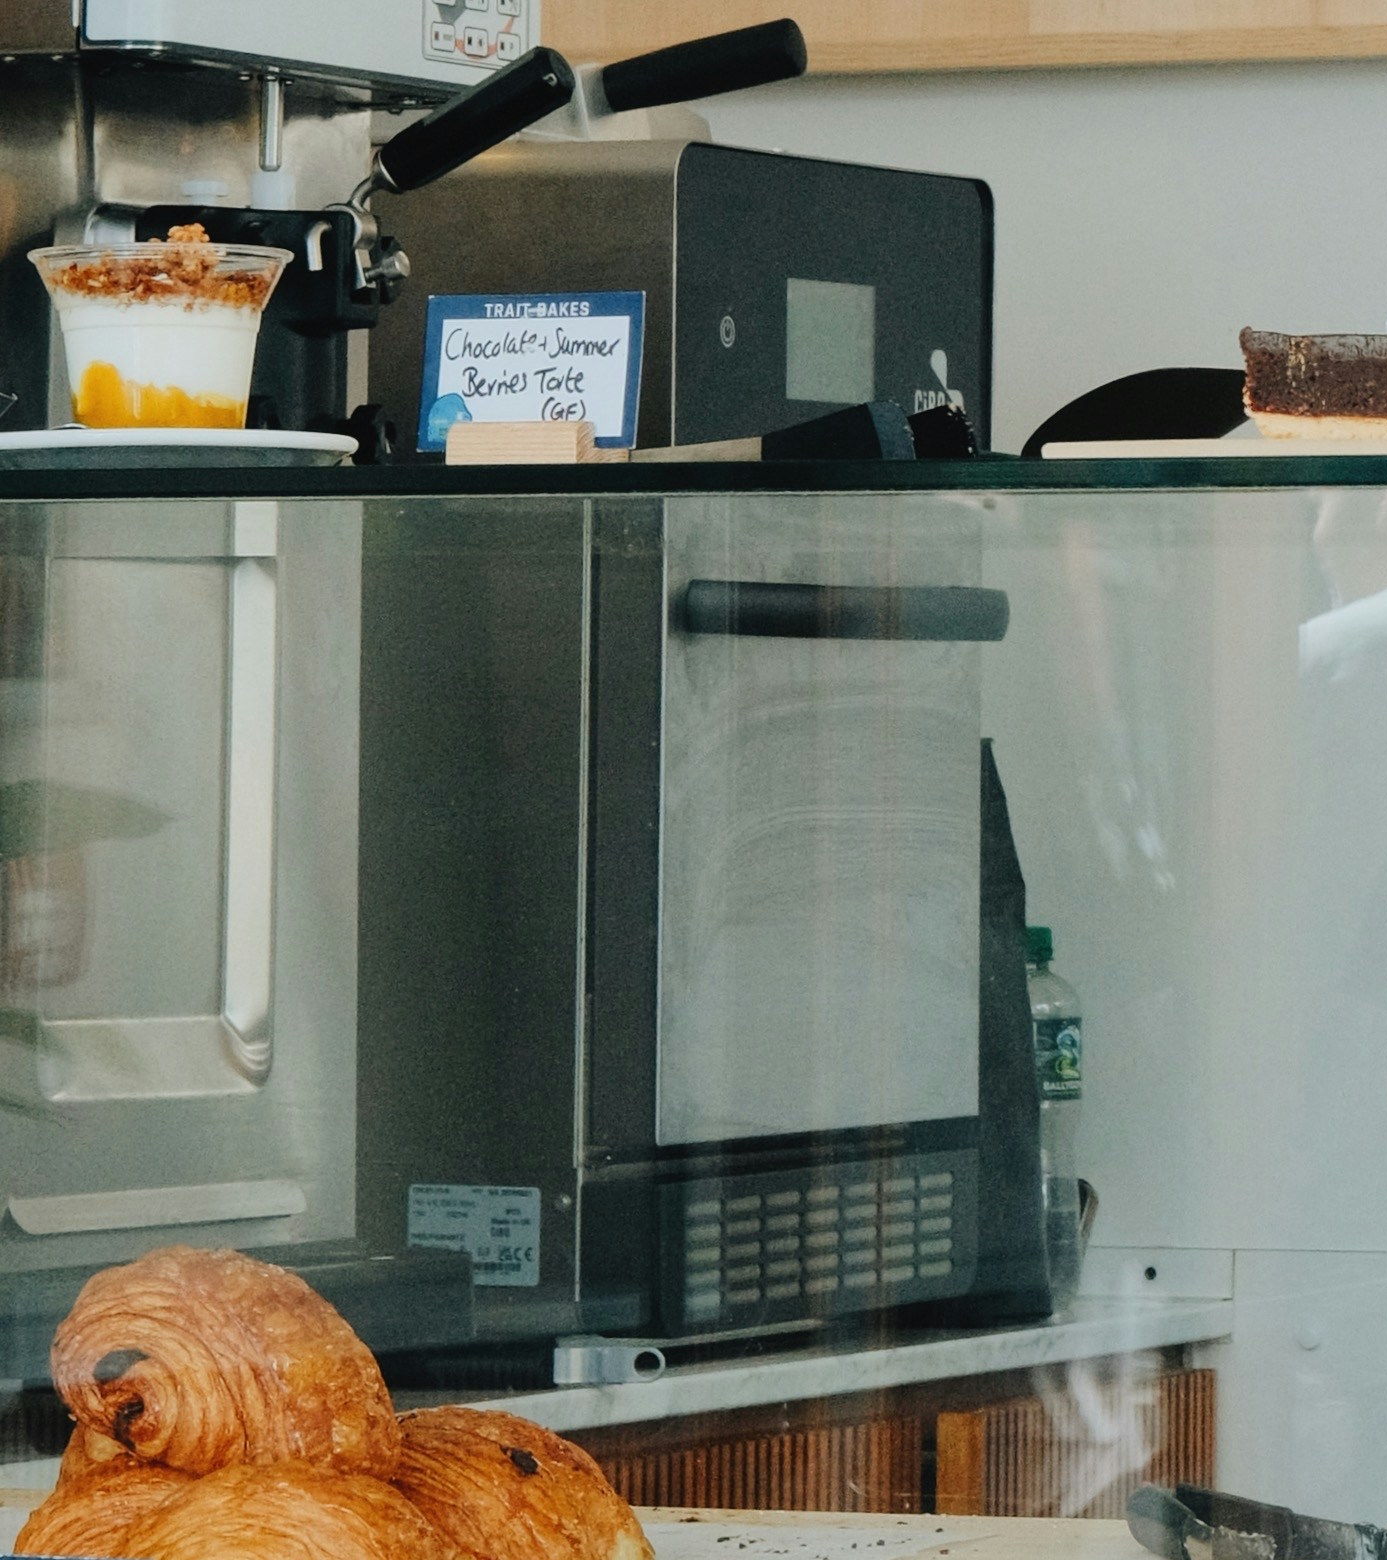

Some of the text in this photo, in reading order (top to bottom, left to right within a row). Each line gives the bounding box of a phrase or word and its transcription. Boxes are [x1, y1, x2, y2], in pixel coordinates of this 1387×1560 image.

[483, 302, 532, 318] TRAIT
[548, 326, 621, 360] Summer
[461, 365, 528, 398] Berries
[541, 396, 587, 422] (GF)
